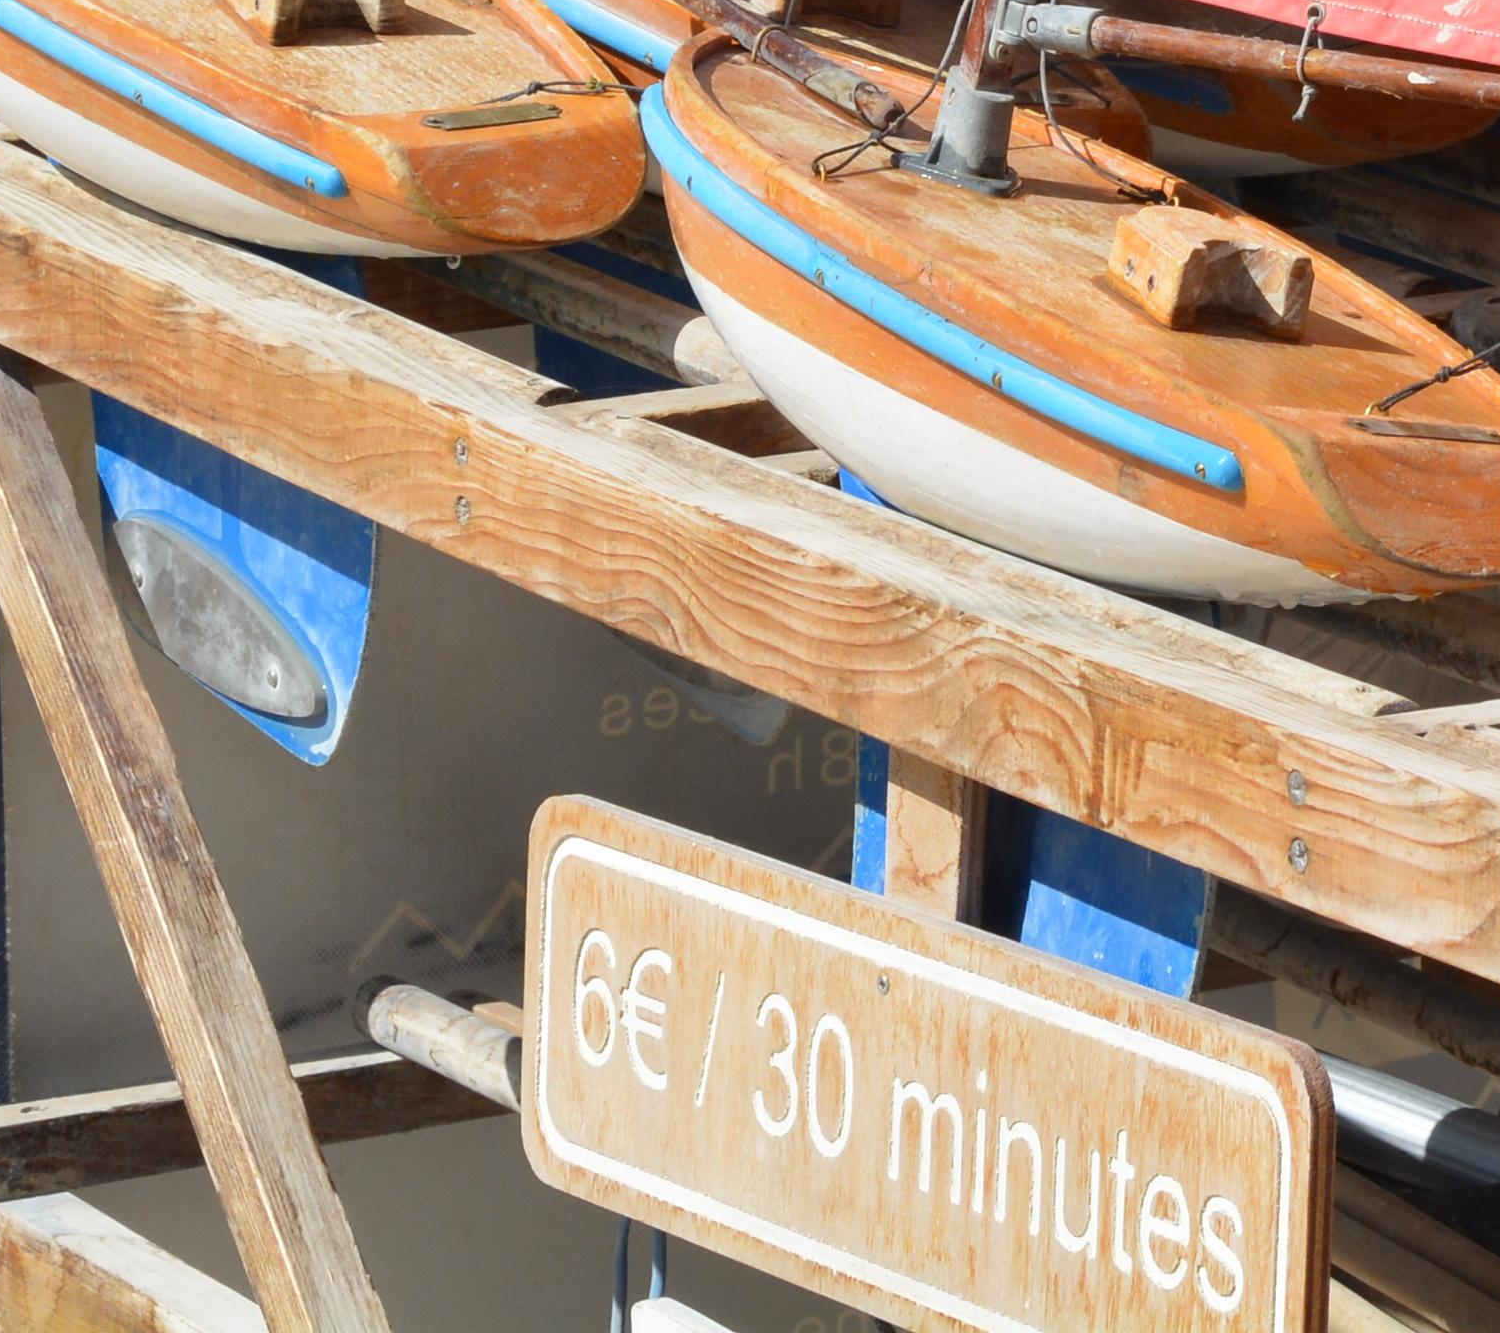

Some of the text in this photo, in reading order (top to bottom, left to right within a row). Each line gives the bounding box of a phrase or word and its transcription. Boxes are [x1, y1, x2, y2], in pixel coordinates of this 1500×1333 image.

[573, 929, 1244, 1313] 6€ / 30 minutes
